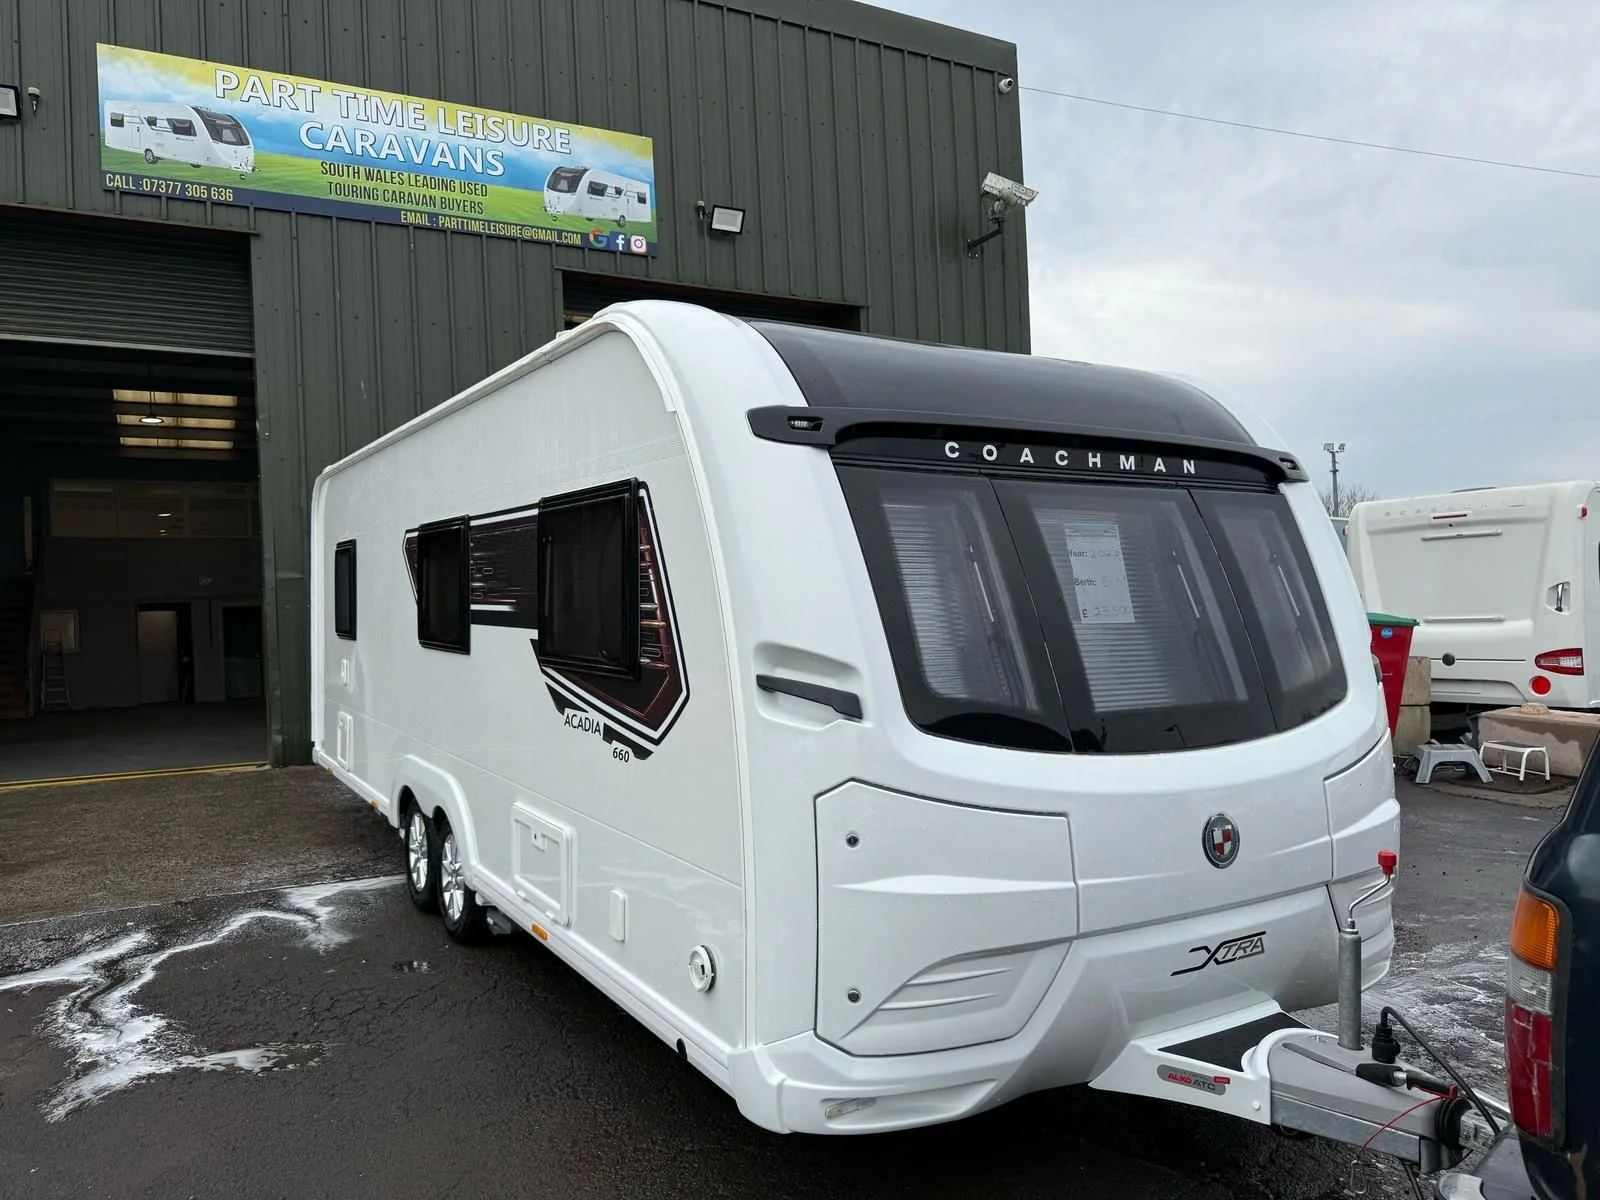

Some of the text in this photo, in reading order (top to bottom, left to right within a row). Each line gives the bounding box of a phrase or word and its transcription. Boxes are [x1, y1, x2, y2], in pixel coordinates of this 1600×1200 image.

[214, 69, 572, 155] PART TIME LEISURE
[299, 121, 506, 177] CARAVANS
[105, 173, 137, 190] CALL
[185, 183, 208, 199] 305
[211, 187, 234, 202] 636
[320, 161, 488, 198] SOUTH WALES LEADING USED
[327, 181, 484, 215] TOURING CARAVAN BUYERS
[400, 210, 431, 227] EMAIL
[438, 214, 582, 246] PARTTIMELEISURE@GMAIL.COM
[944, 441, 1196, 475] COACHMAN
[1074, 577, 1097, 587] Berth:
[564, 713, 602, 737] ACADIA
[612, 747, 630, 763] 660
[1170, 931, 1267, 977] XTRA
[1193, 1079, 1216, 1091] ATC
